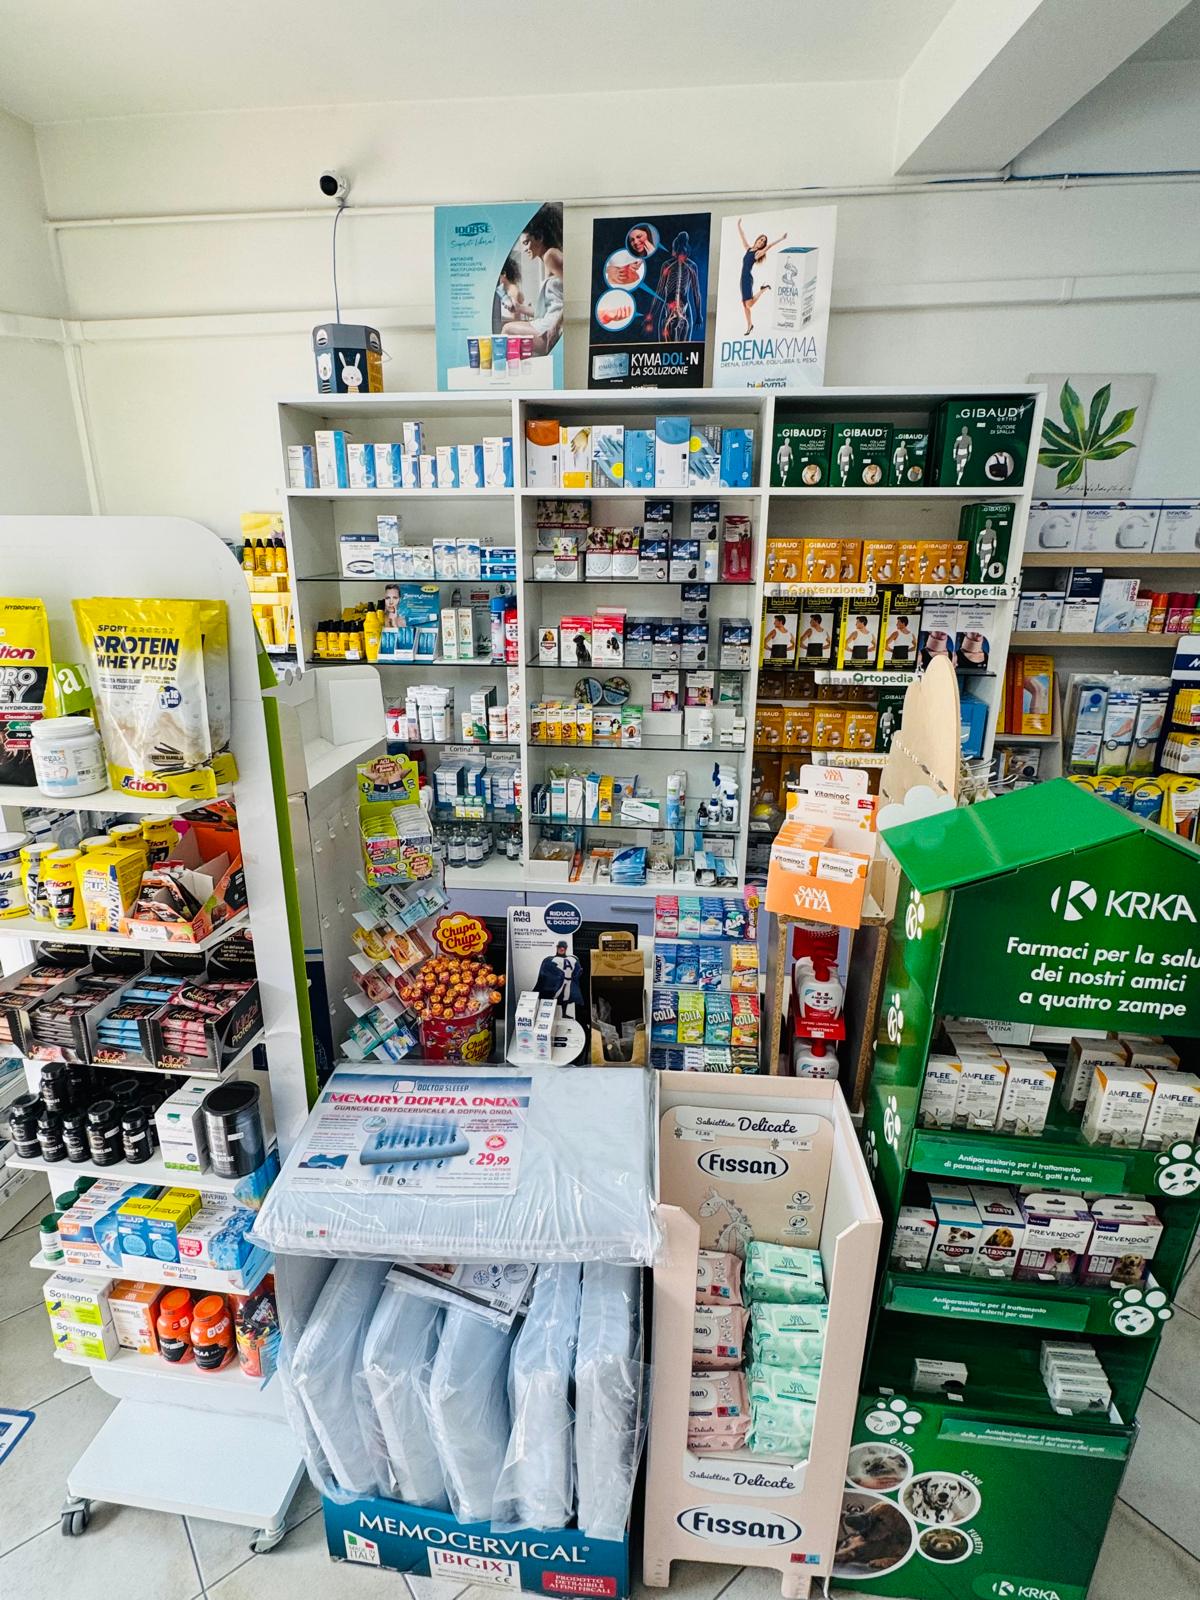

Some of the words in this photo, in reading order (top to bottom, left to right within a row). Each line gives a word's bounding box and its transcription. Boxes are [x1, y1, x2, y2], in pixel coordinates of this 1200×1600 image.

[721, 336, 817, 362] DRENAKYMA
[631, 367, 641, 376] LA
[642, 366, 688, 376] SOLUZIONE
[961, 408, 1017, 418] GIBAUD
[782, 428, 821, 437] GIBAUD
[843, 428, 882, 437] GIBAUD
[788, 584, 865, 594] Contenzione
[944, 585, 1008, 597] Ortopedia
[97, 624, 128, 633] SPORT
[94, 635, 180, 656] PROTEIN
[97, 653, 140, 669] WHEY
[142, 656, 177, 671] PLUS
[853, 672, 914, 684] Ortopedia
[814, 790, 845, 800] Vitamina
[775, 855, 800, 865] Vitamina
[822, 863, 848, 874] Vitamina
[799, 885, 828, 901] SANA
[793, 890, 832, 913] VITA
[1105, 890, 1197, 923] KRKA
[441, 920, 477, 940] Chupa
[446, 932, 481, 950] Chups
[1006, 936, 1090, 960] Farmaci
[1093, 945, 1129, 966] per
[1134, 944, 1154, 965] la
[1030, 962, 1064, 983] dei
[1068, 969, 1126, 987] nostri
[1130, 972, 1188, 992] amici
[1018, 991, 1033, 1004] a
[1038, 993, 1112, 1011] quattro
[1117, 999, 1187, 1020] zampe
[961, 1072, 995, 1080] AMFLEE
[1010, 1077, 1045, 1086] AMFLEE
[330, 1094, 403, 1105] MEMORY
[404, 1095, 468, 1106] DOPPIA
[471, 1096, 521, 1107] ONDA
[1108, 1090, 1143, 1098] AMFLEE
[1158, 1093, 1194, 1103] AMFLEE
[382, 1106, 448, 1114] ORTOCERVICALE
[737, 1116, 798, 1134] Delicate
[469, 1158, 475, 1166] €
[476, 1152, 510, 1167] 29,99
[708, 1153, 777, 1175] Fissan
[958, 1154, 1016, 1167] Antiparassitario
[1038, 1163, 1081, 1173] trattamento
[953, 1163, 984, 1172] parassiti
[1070, 1174, 1093, 1183] furetti
[1029, 1228, 1081, 1238] PREVENDOG
[1097, 1235, 1150, 1243] PREVENDOG
[938, 1245, 970, 1253] Ataxxa
[980, 1247, 1012, 1256] Ataxxa
[49, 1289, 93, 1303] Sostegno
[56, 1322, 98, 1338] Sostegno
[889, 1438, 914, 1454] GATTI
[733, 1472, 796, 1490] Delicate
[961, 1470, 983, 1486] CANI
[693, 1512, 786, 1540] Fissan
[967, 1528, 983, 1554] FURETTI
[350, 1551, 376, 1562] ITALY
[555, 1575, 604, 1584] PRODOTTO
[555, 1579, 604, 1588] DETRAIBILE
[1018, 1586, 1060, 1600] KRKA
